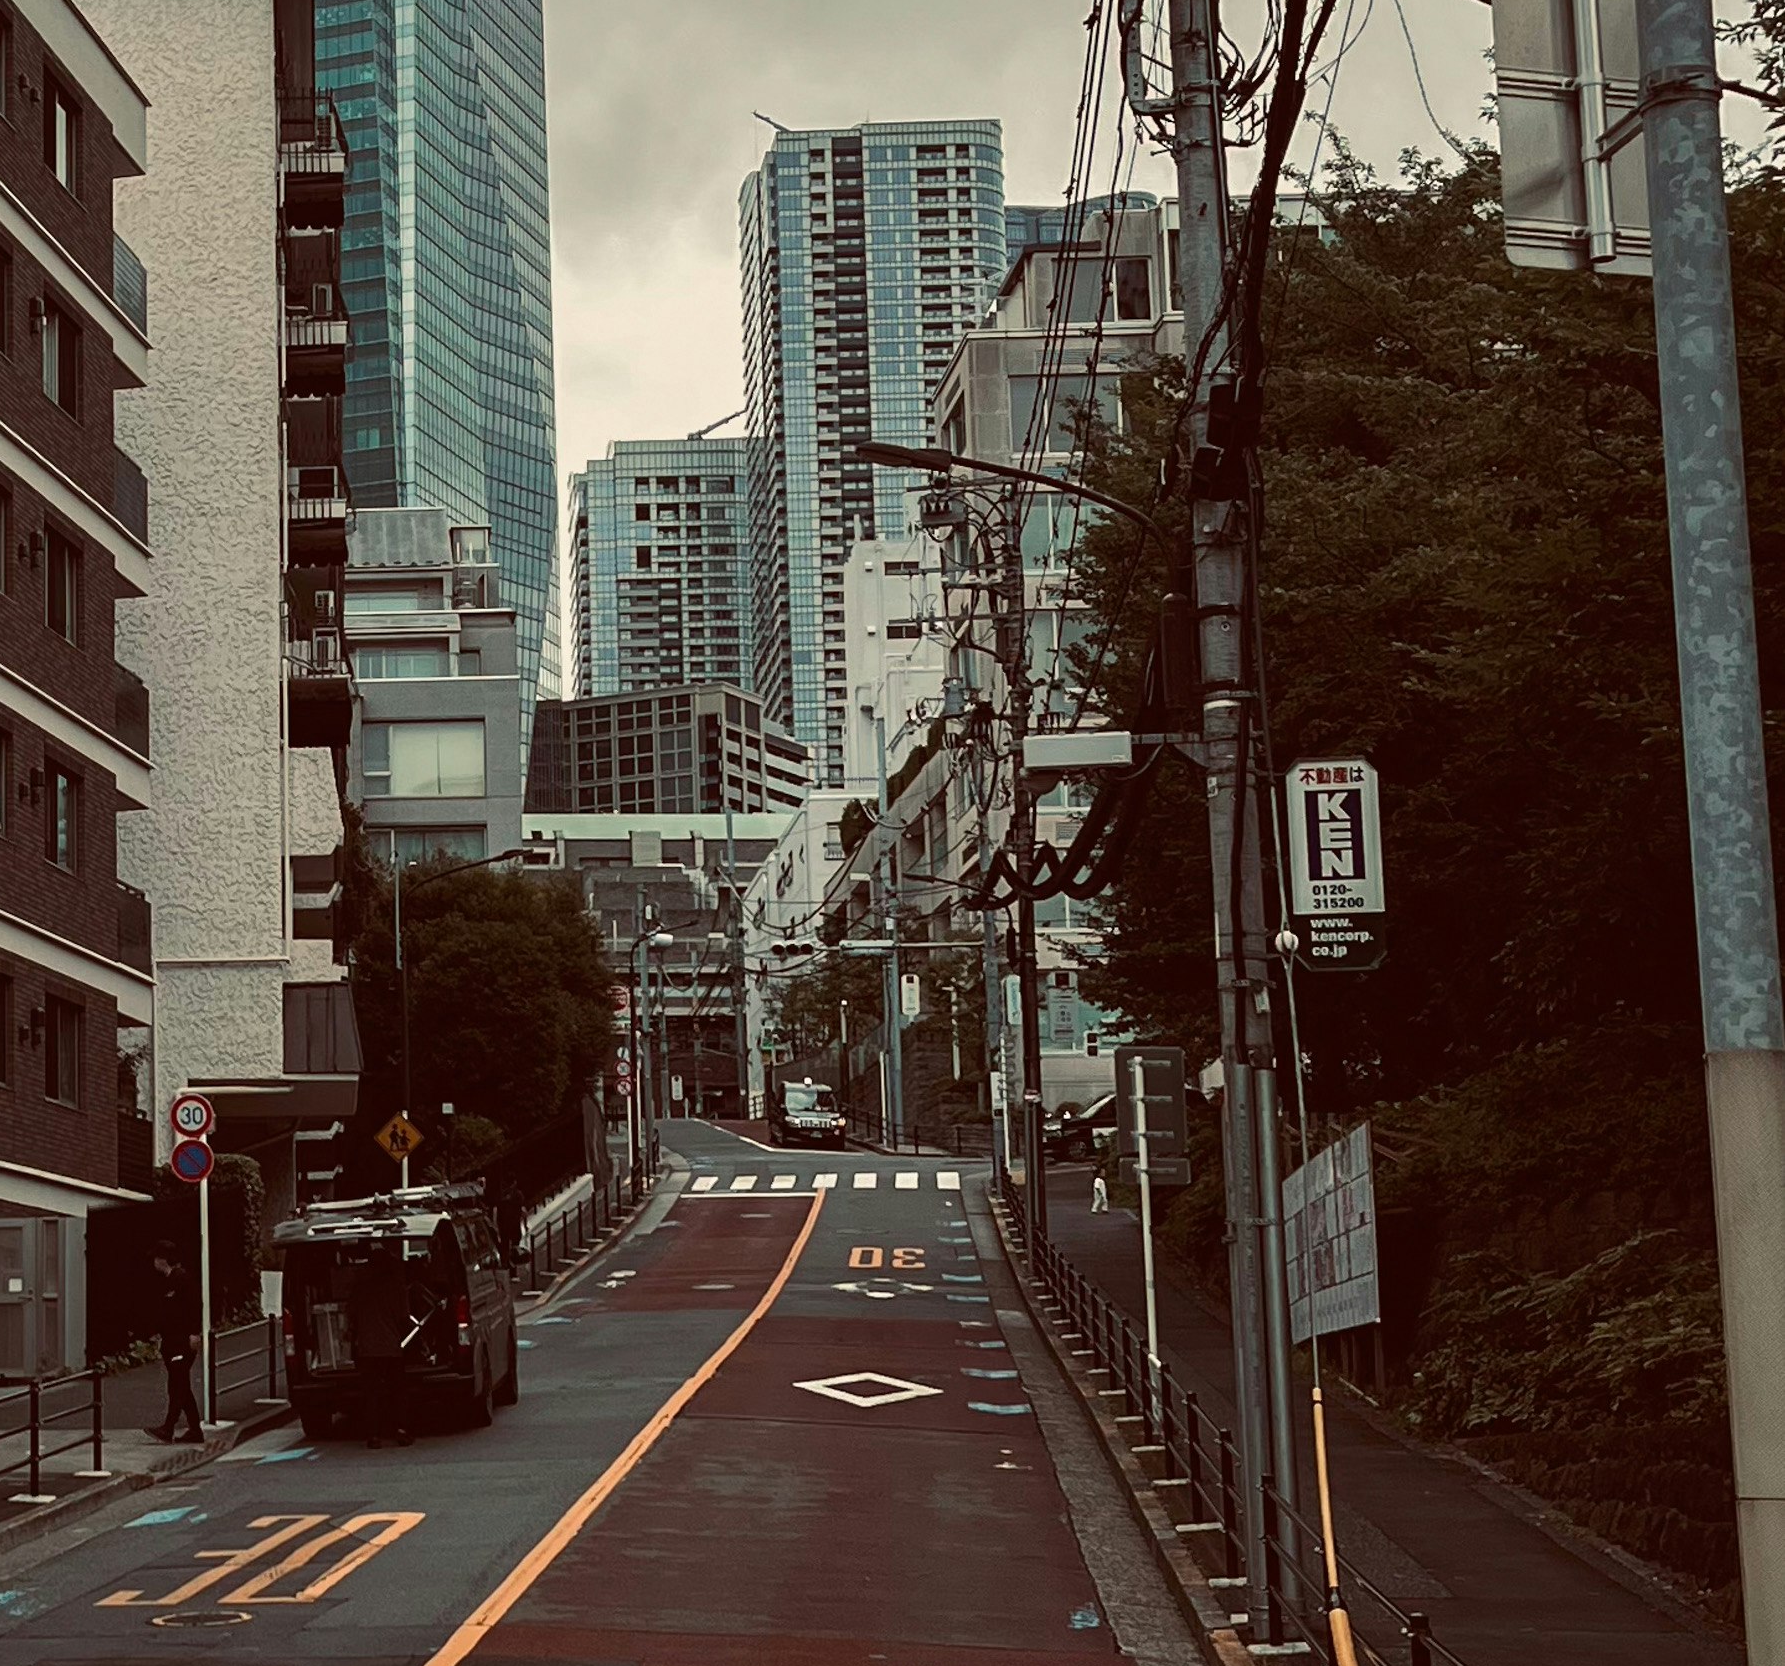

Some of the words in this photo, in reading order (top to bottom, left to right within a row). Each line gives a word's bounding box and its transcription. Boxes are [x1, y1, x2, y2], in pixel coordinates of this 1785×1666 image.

[1299, 766, 1365, 785] 不動産は
[1317, 792, 1354, 878] KEN
[1312, 884, 1352, 896] 0120-
[1313, 897, 1364, 909] 315200
[1310, 918, 1353, 928] www.
[1310, 931, 1374, 943] kencorp.
[1312, 944, 1348, 957] co.jp
[180, 1106, 204, 1125] 30
[93, 1512, 426, 1606] 30
